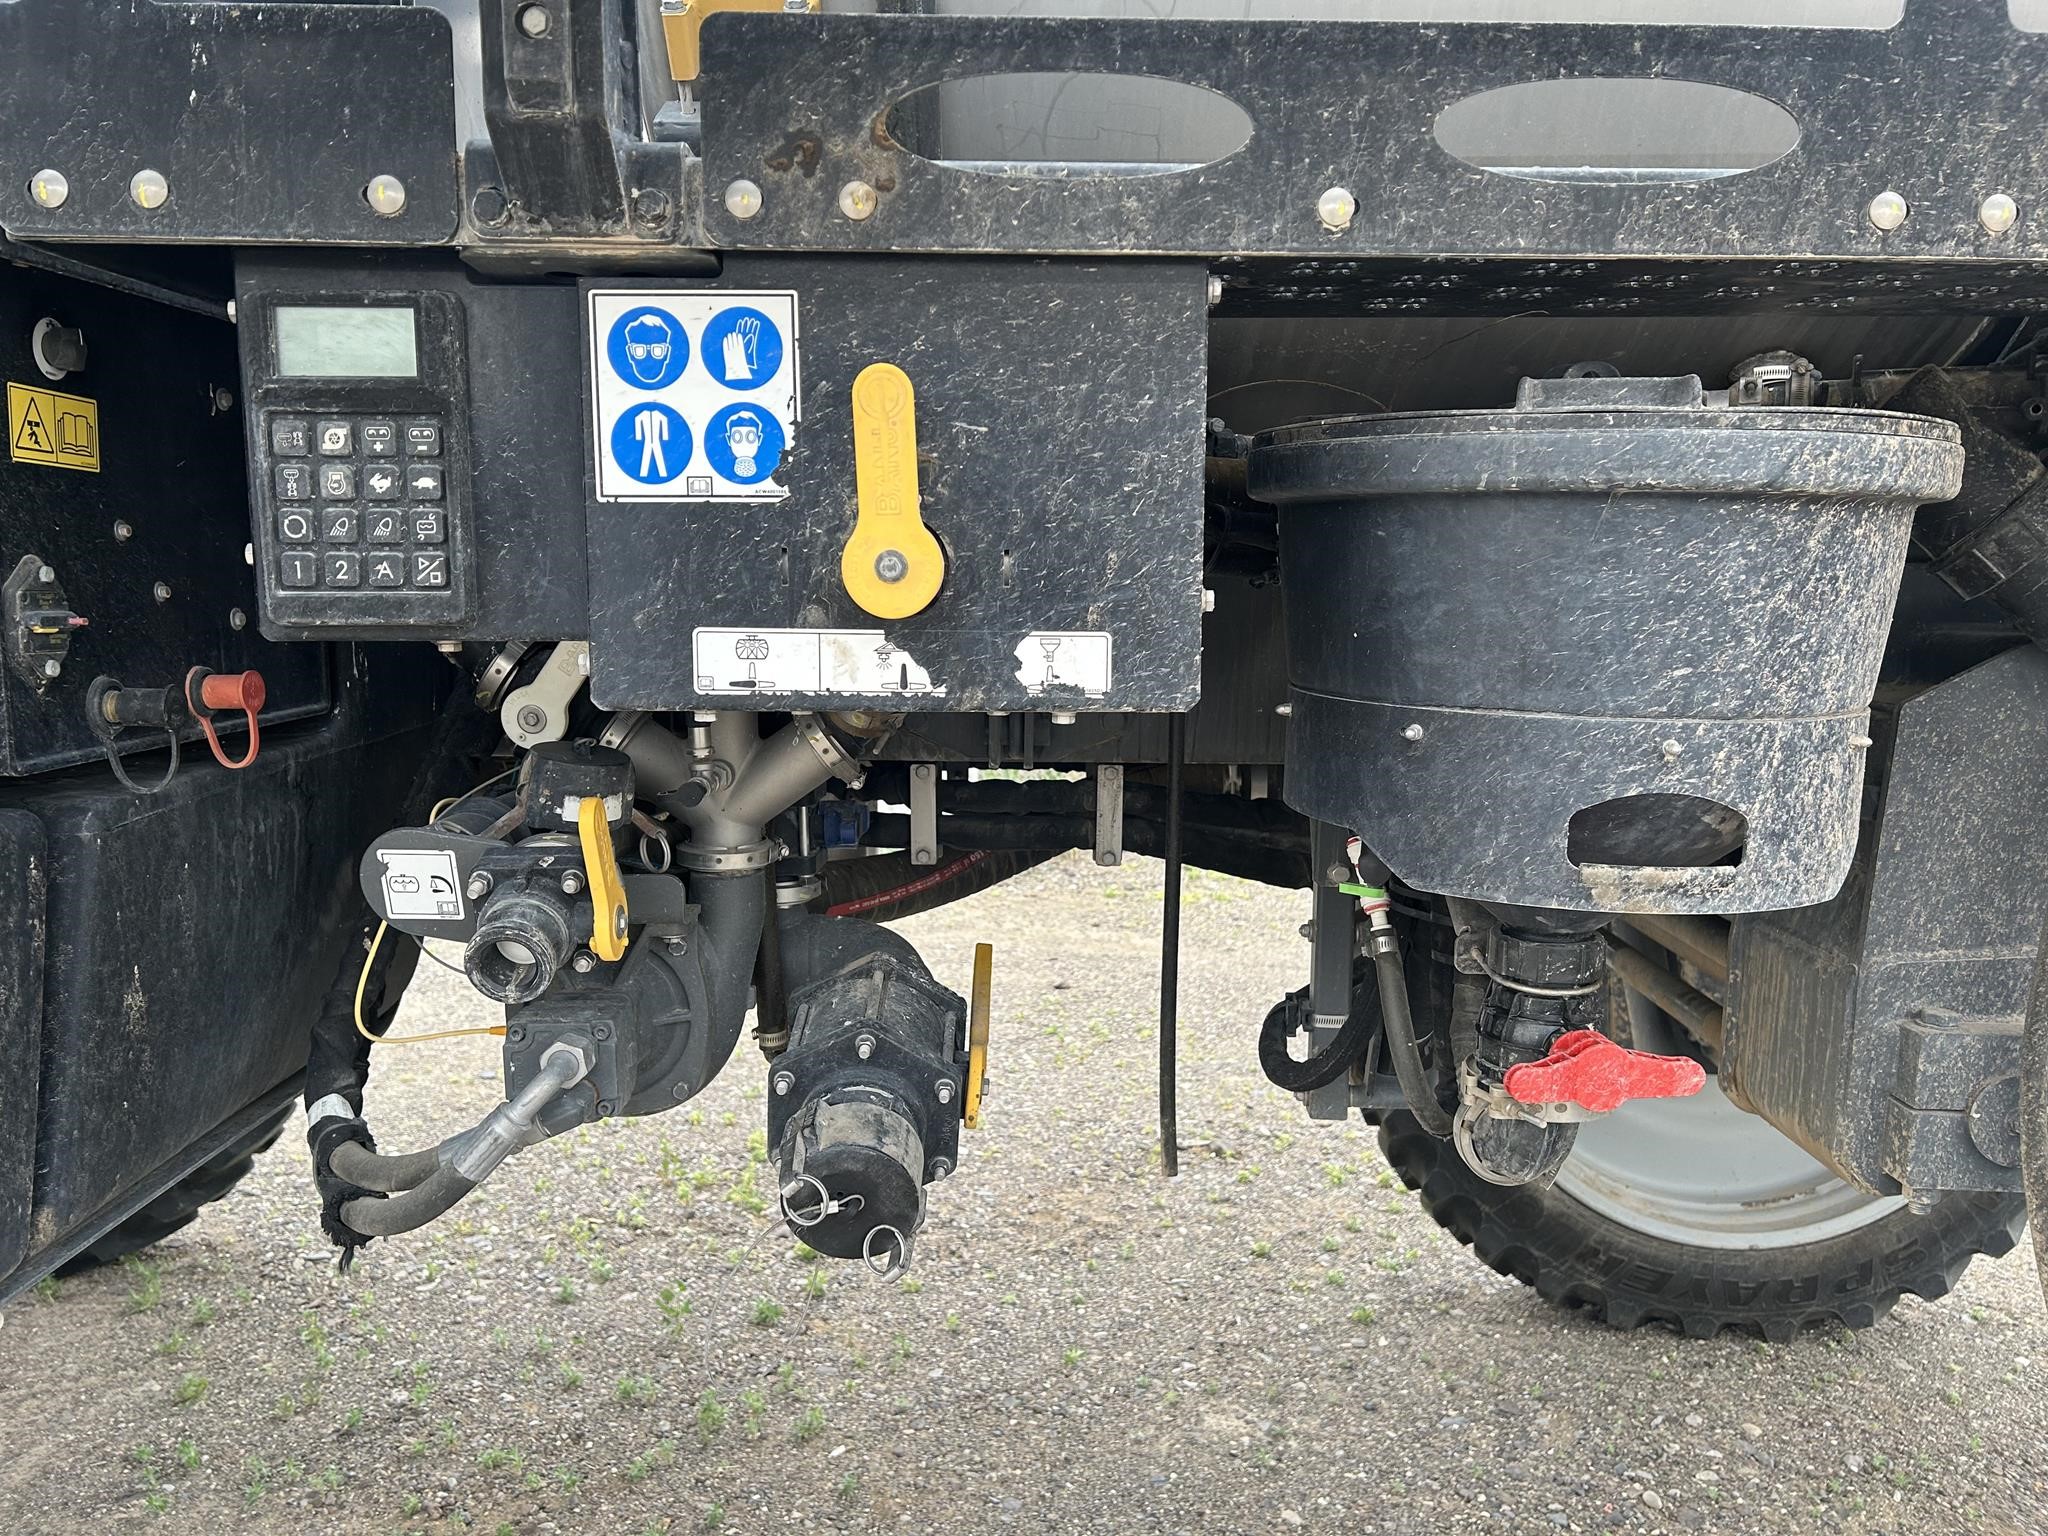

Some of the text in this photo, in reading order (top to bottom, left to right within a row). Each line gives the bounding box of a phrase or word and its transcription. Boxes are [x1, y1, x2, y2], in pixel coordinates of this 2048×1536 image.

[294, 560, 301, 579] 1
[335, 560, 349, 580] 2
[377, 560, 394, 579] A
[1571, 1237, 1926, 1306] SPRAYER
